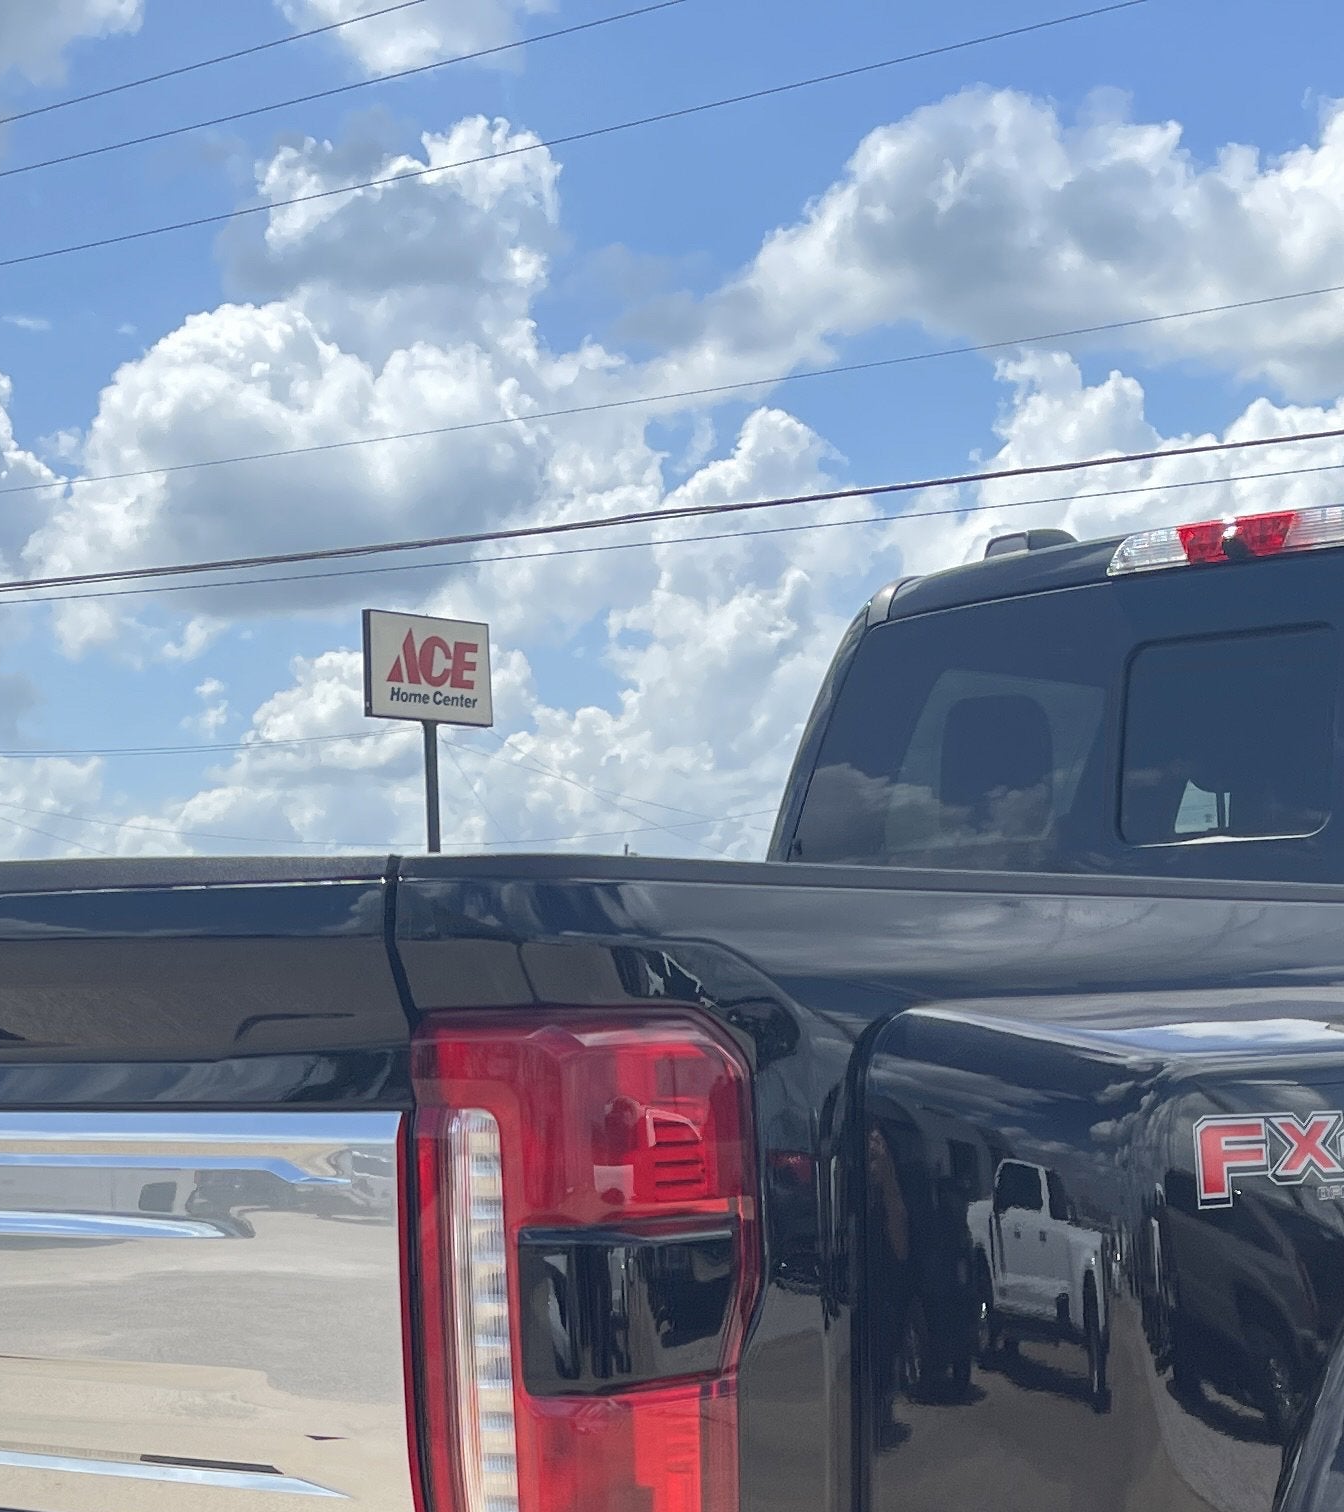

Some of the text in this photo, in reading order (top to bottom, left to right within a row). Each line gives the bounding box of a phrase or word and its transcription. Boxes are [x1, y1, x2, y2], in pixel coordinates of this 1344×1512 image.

[386, 627, 479, 690] ACE
[390, 686, 478, 709] Home Center
